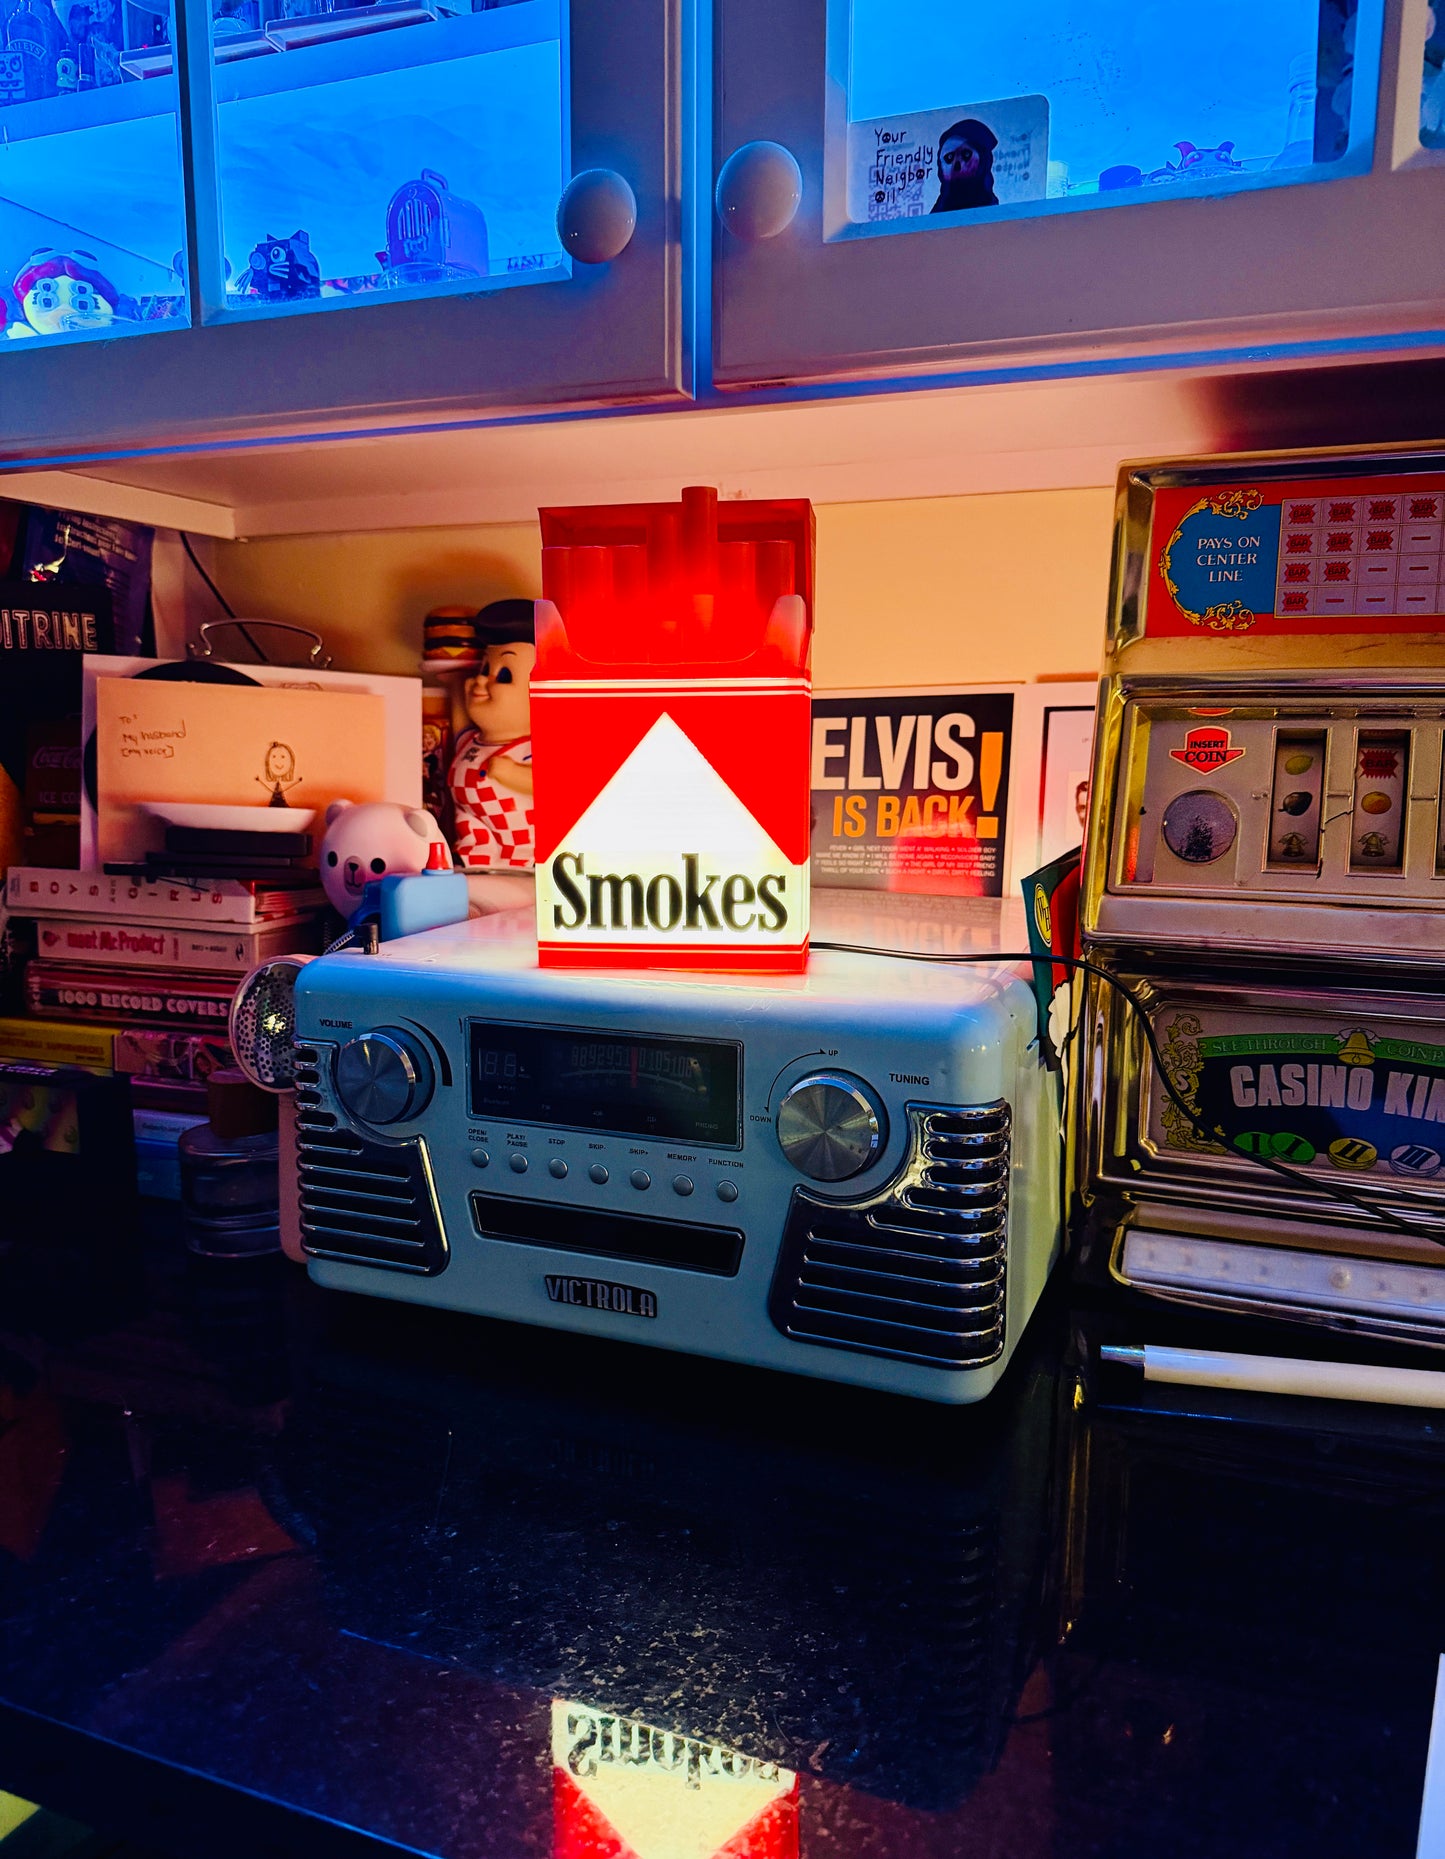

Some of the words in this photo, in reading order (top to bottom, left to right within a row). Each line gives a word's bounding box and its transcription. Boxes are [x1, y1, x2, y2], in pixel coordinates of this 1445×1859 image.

[874, 128, 907, 146] Your
[876, 145, 933, 168] Friendly
[1197, 537, 1233, 549] PAYS
[1237, 536, 1261, 548] ON
[1196, 553, 1257, 566] CENTER
[1209, 571, 1244, 583] LINE
[0, 609, 98, 651] ITRINE
[1190, 740, 1225, 749] INSERT
[811, 713, 976, 791] ELVIS
[1184, 749, 1229, 763] COIN
[832, 795, 867, 838] IS
[876, 794, 975, 839] BACK
[552, 852, 788, 932] Smokes
[58, 989, 98, 1006] 1000
[101, 994, 163, 1012] RECORD
[166, 998, 228, 1017] COVERS
[319, 1018, 353, 1029] VOLUME
[889, 1073, 930, 1086] TUNING
[1230, 1063, 1374, 1111] CASINO
[750, 1115, 772, 1124] DOWN
[468, 1135, 489, 1143] CLOSE
[667, 1153, 697, 1161] MEMORY
[708, 1158, 744, 1168] FUNCTION
[546, 1277, 655, 1317] VICTROLA
